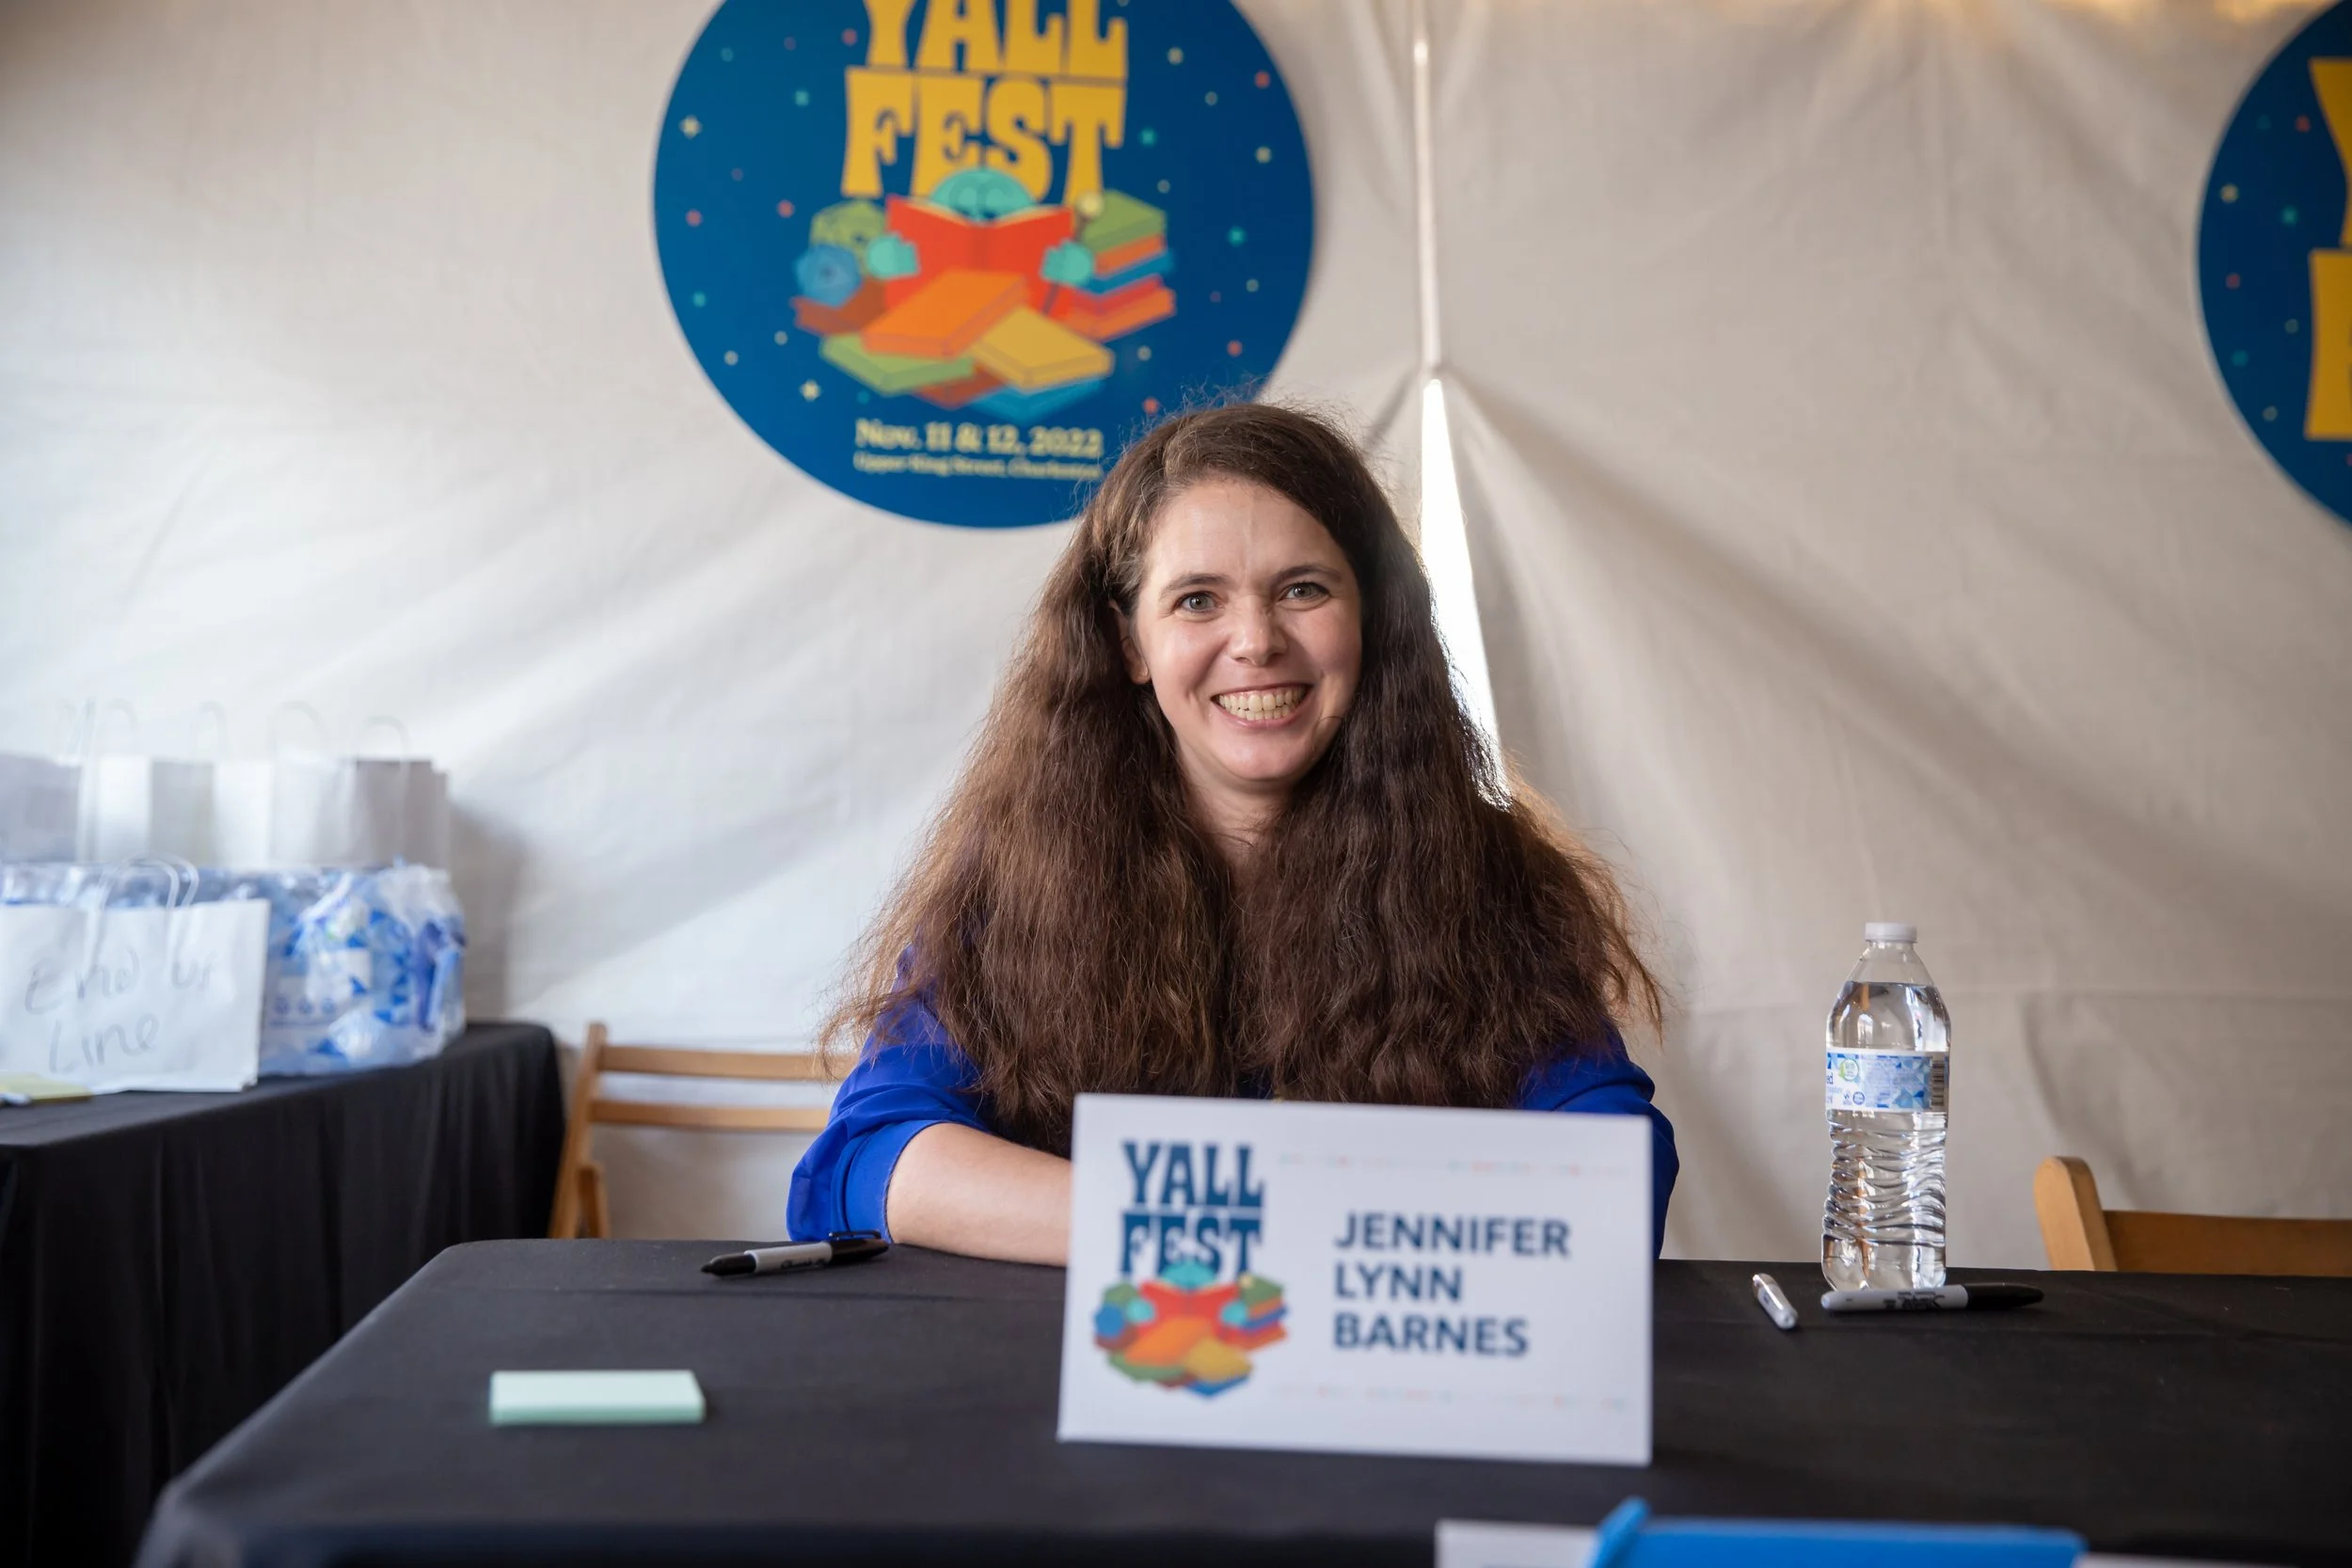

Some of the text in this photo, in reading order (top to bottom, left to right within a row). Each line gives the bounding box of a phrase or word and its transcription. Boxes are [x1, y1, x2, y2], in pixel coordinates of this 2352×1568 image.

[864, 0, 1128, 79] YALL
[841, 66, 1126, 203] FEST
[1121, 1140, 1264, 1209] YALL
[1120, 1210, 1263, 1278] FEST
[1333, 1212, 1571, 1258] JENNIFER
[1334, 1261, 1464, 1302] LYNN
[1333, 1311, 1530, 1358] BARNES
